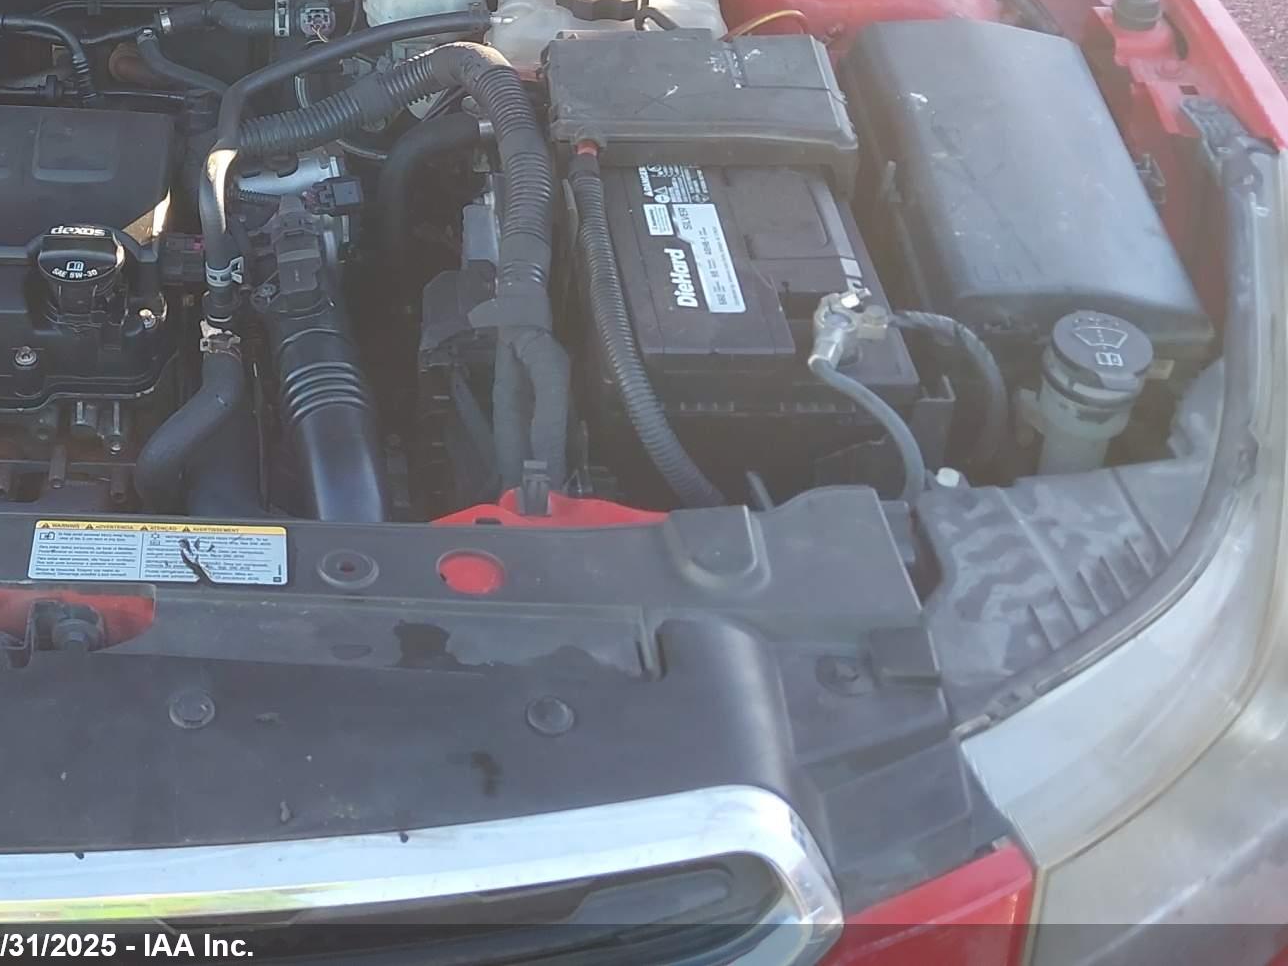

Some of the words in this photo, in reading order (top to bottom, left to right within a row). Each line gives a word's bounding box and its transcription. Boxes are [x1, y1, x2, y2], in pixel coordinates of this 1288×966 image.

[50, 225, 106, 237] dexos
[52, 267, 68, 278] SAE
[69, 268, 98, 279] 5W-30
[663, 247, 699, 308] DieHard
